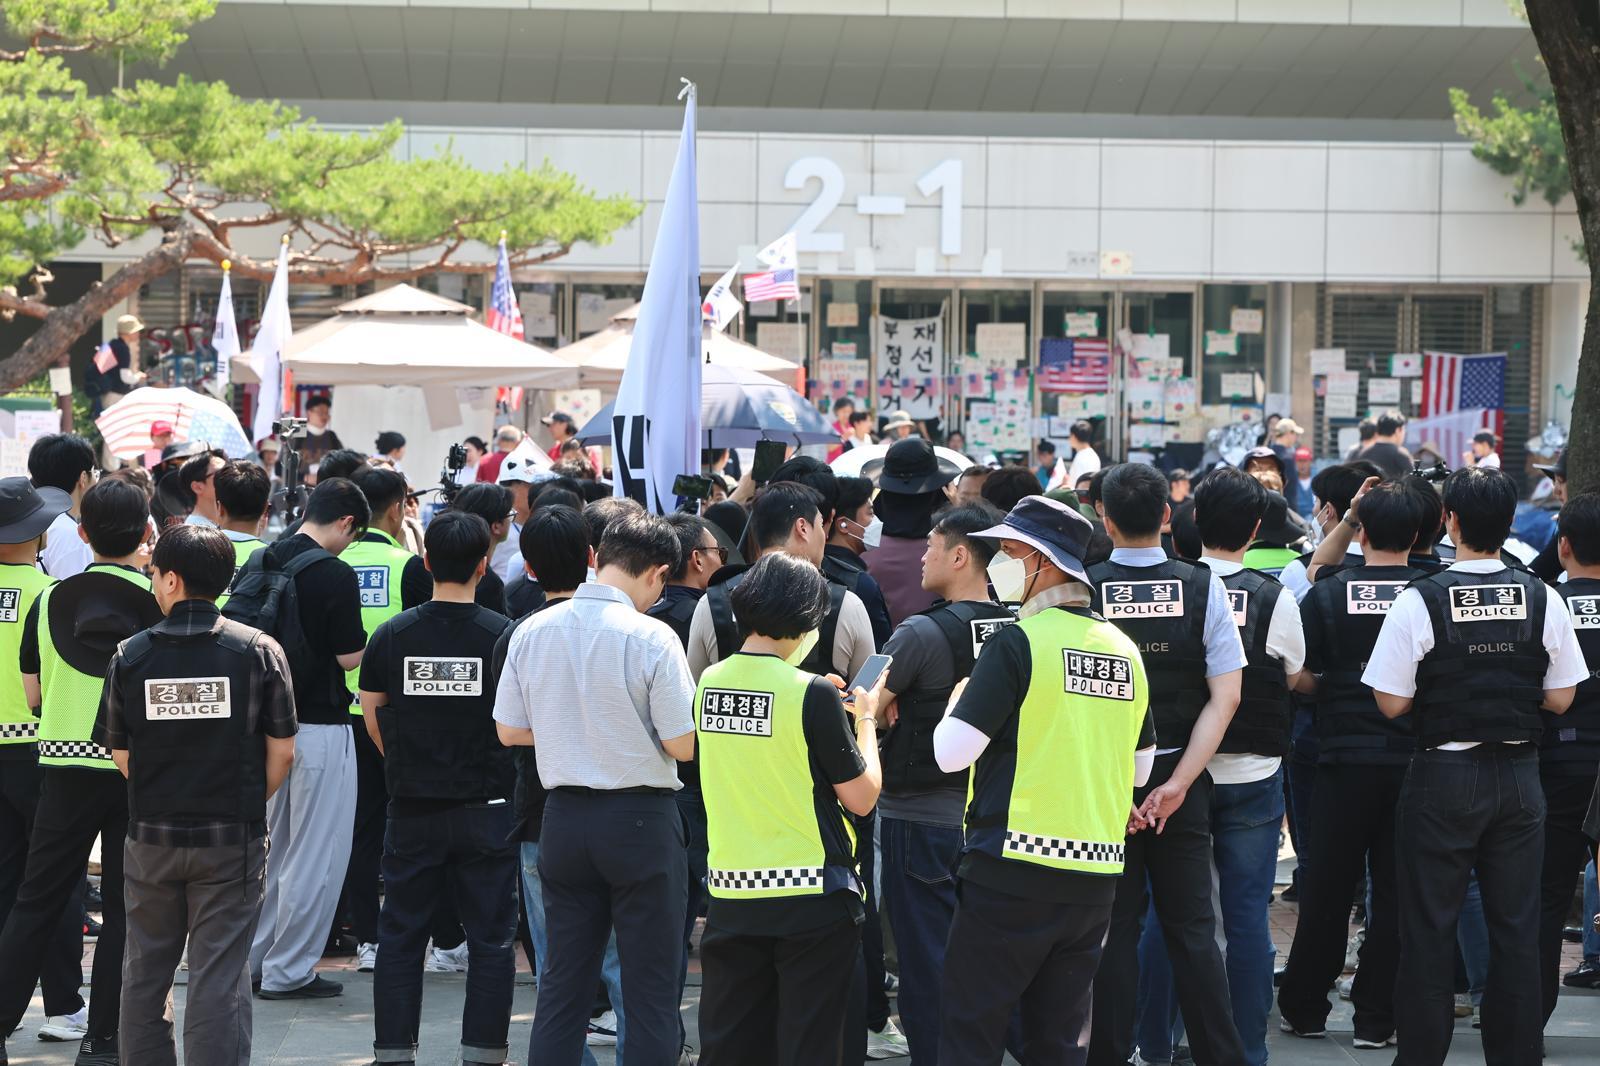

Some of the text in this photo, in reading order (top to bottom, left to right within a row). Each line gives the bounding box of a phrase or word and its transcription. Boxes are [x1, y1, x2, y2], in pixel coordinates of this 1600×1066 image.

[784, 156, 963, 255] 2-1
[882, 321, 901, 410] 부정선거
[1112, 584, 1172, 602] 경찰
[1459, 588, 1516, 606] 경찰
[1113, 604, 1174, 614] POLICE
[1461, 608, 1517, 617] POLICE
[1469, 642, 1515, 654] POLICE
[414, 663, 472, 680] 경찰
[1070, 656, 1128, 681] 대화경찰
[157, 683, 219, 702] 경찰
[413, 682, 472, 692] POLICE
[1072, 678, 1126, 698] POLICE
[157, 704, 219, 715] POLICE
[706, 694, 767, 717] 대화경찰
[707, 717, 764, 733] POLICE
